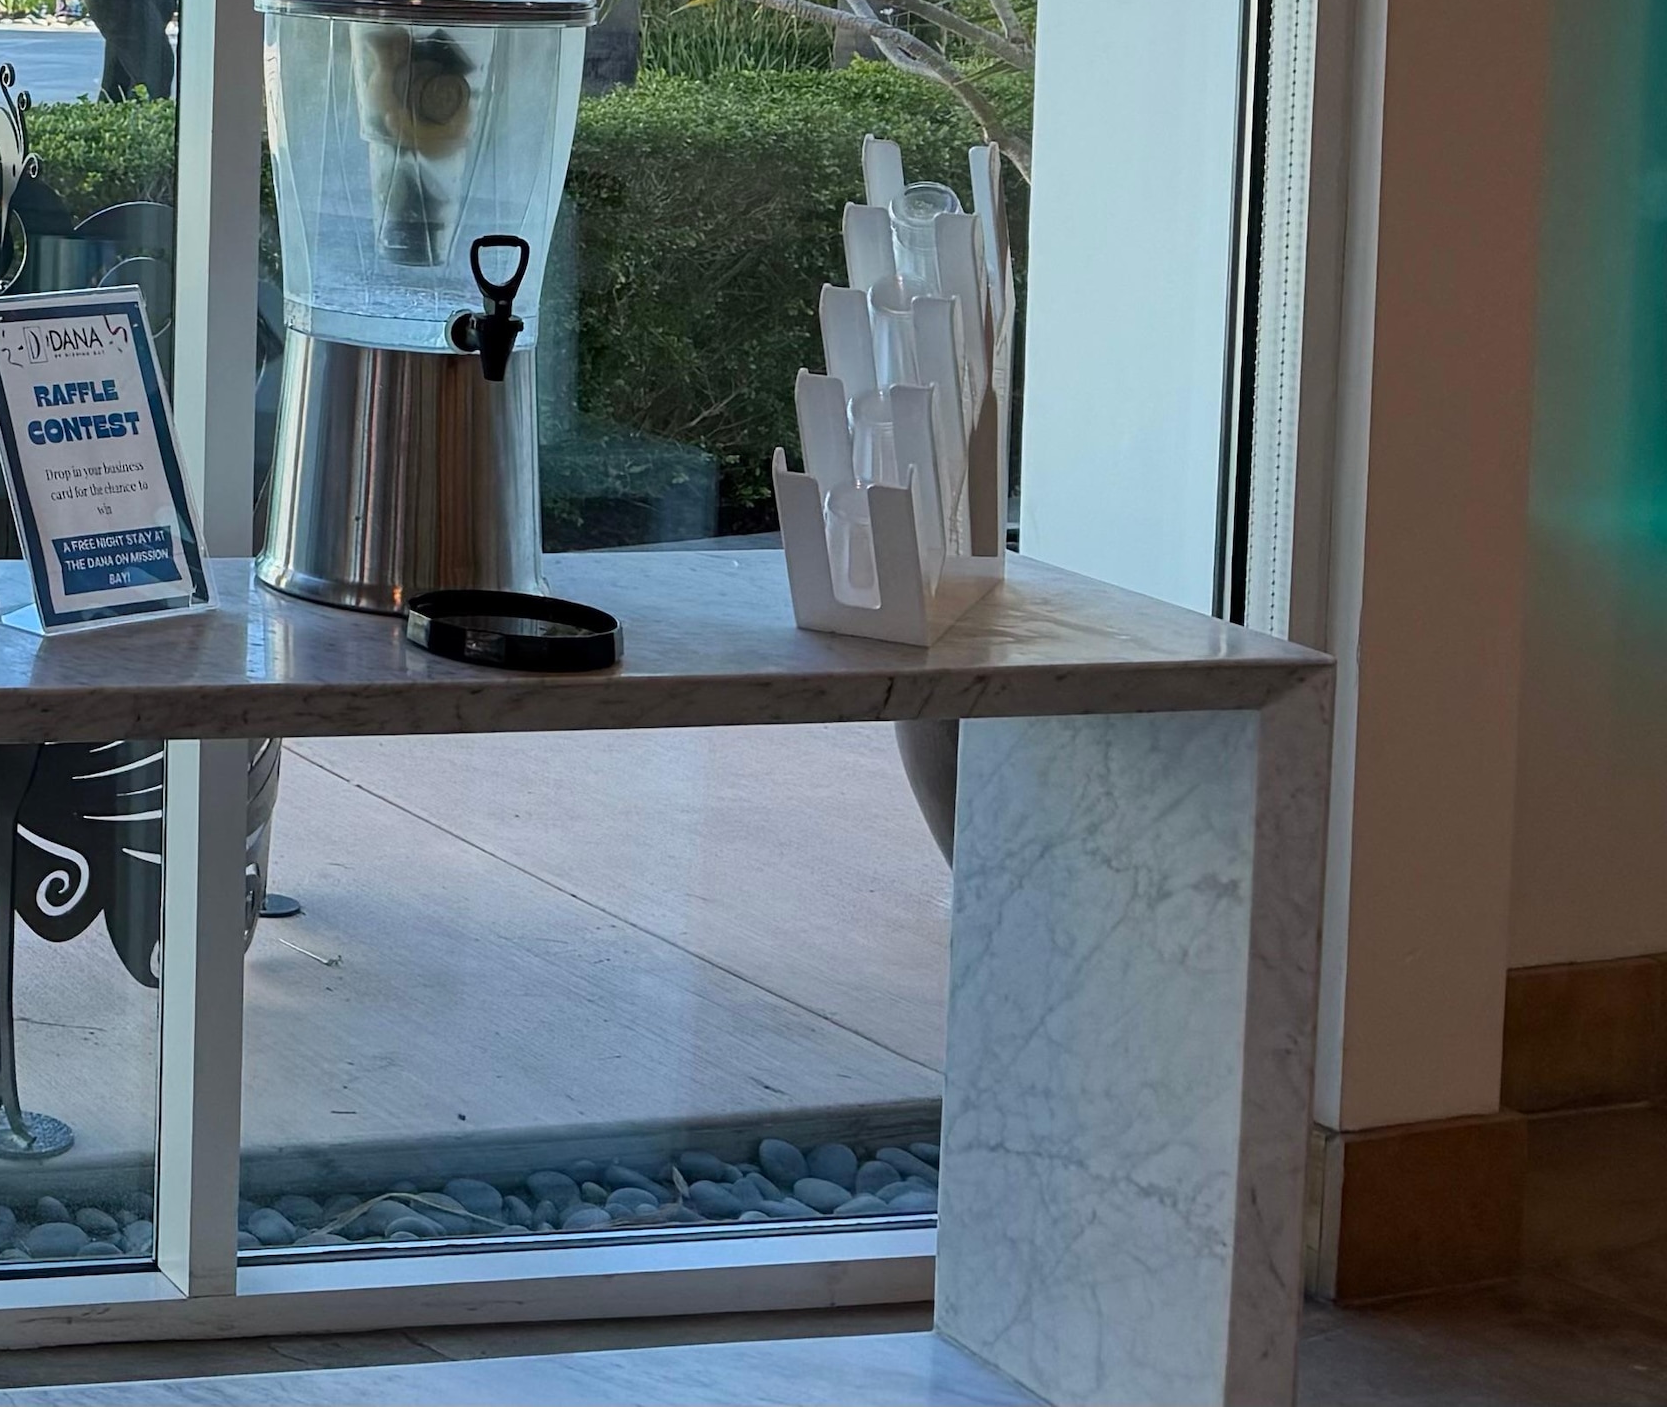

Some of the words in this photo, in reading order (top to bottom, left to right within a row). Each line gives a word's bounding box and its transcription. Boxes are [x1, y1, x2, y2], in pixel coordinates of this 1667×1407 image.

[49, 326, 104, 352] DANA
[33, 379, 119, 407] RAFFLE
[28, 411, 140, 445] CONTEST
[45, 467, 71, 482] Drop
[72, 465, 82, 477] in
[83, 465, 102, 479] your
[103, 460, 144, 475] business
[50, 485, 73, 501] card
[74, 484, 87, 498] for
[89, 482, 103, 496] the
[104, 481, 137, 494] chance
[139, 479, 149, 490] to
[97, 502, 113, 515] win
[63, 542, 71, 553] A
[72, 537, 96, 552] FREE
[96, 534, 124, 549] NIGHT
[126, 530, 153, 545] STAY
[154, 530, 166, 542] AT
[65, 558, 86, 572] THE
[87, 554, 114, 569] DANA
[115, 552, 129, 565] ON
[130, 548, 169, 564] MISSION
